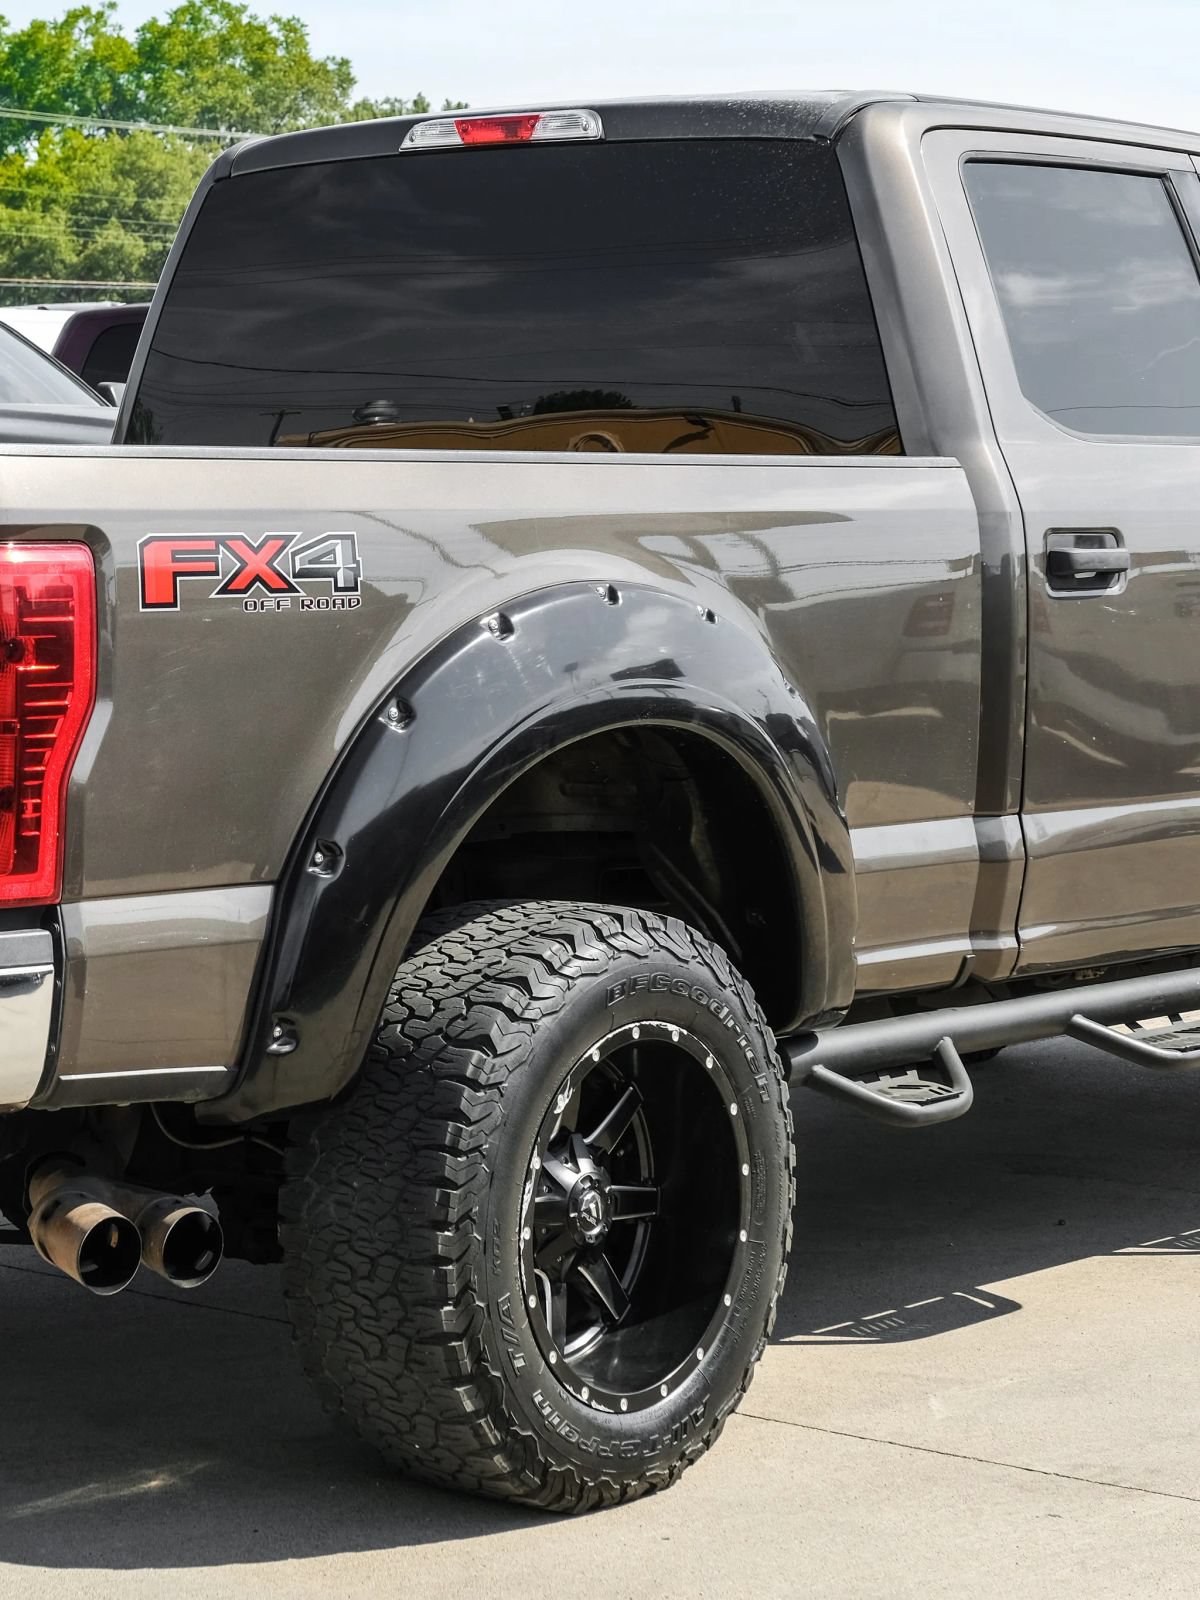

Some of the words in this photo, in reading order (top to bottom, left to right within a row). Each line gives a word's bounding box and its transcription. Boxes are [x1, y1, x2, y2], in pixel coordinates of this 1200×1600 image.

[137, 531, 363, 612] FX4
[243, 597, 291, 613] OFF
[300, 596, 362, 611] ROAD
[606, 971, 770, 1104] BFGoodrich
